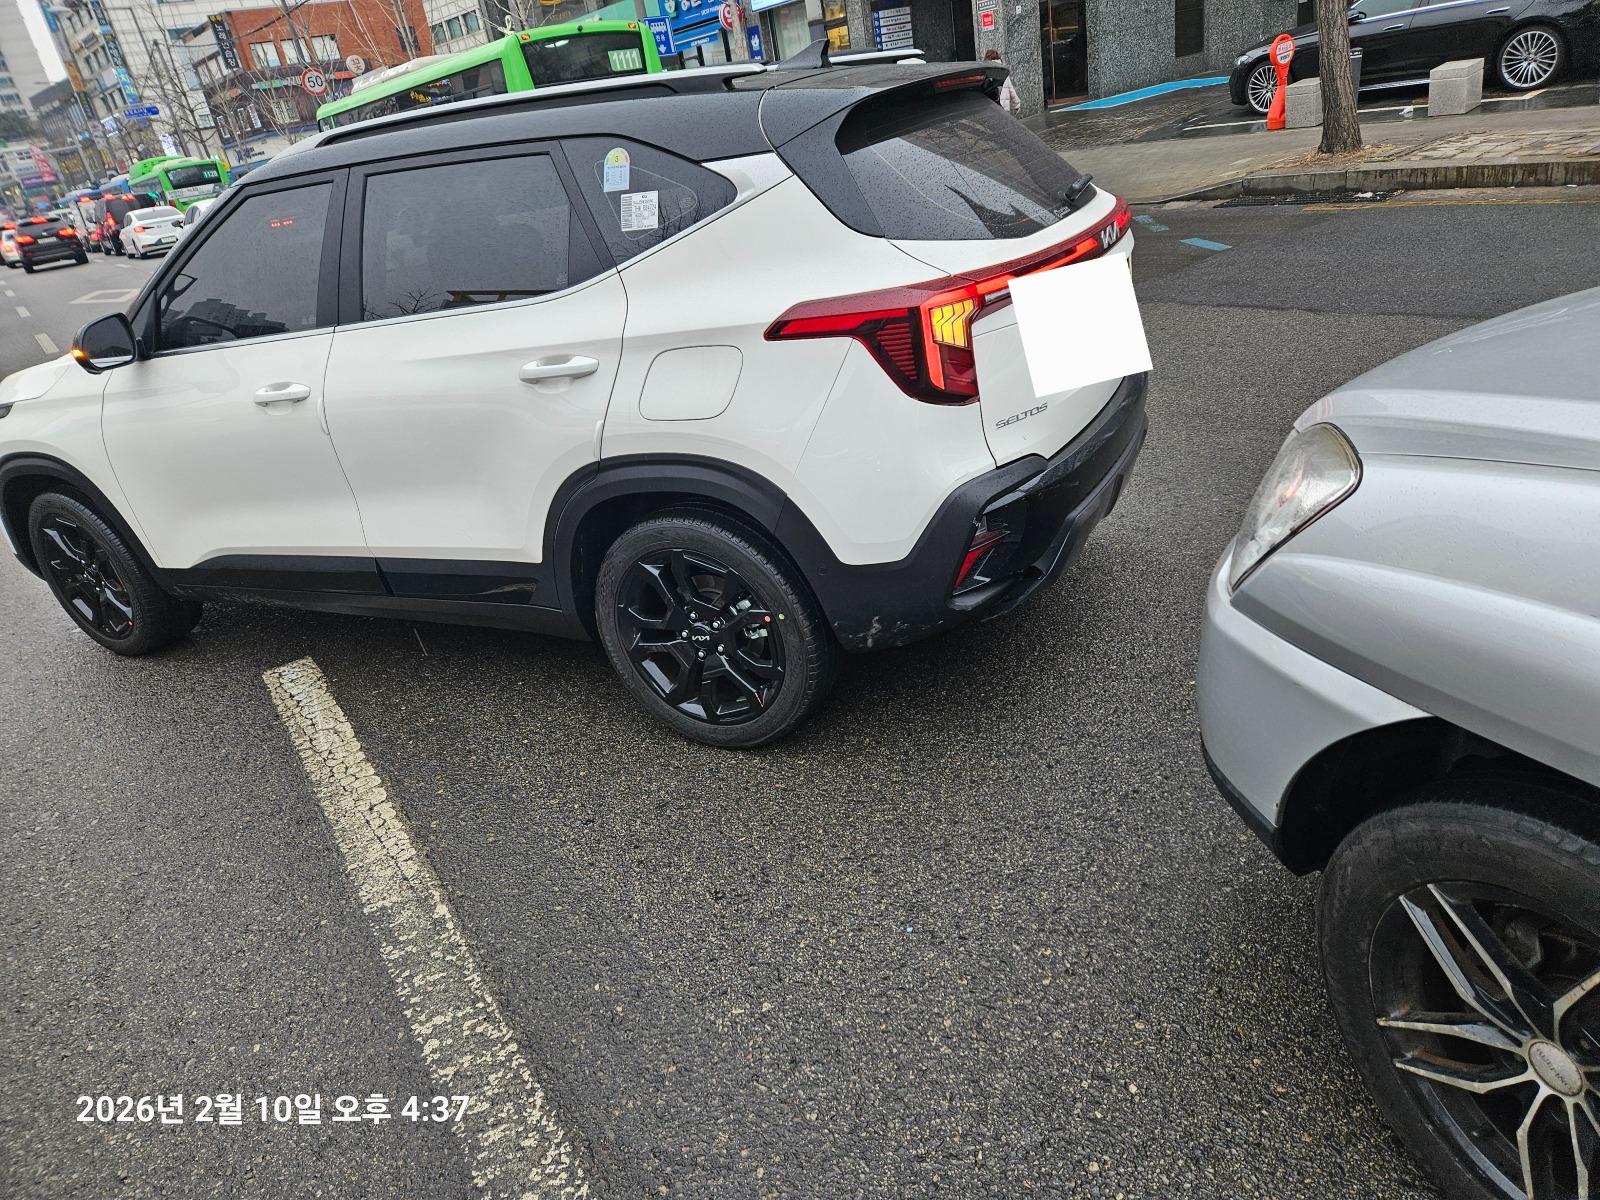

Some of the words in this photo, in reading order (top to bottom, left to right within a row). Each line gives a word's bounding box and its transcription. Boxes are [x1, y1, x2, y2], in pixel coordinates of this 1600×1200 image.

[612, 49, 640, 71] 1111
[307, 75, 324, 88] 50
[1101, 220, 1120, 249] KIA
[995, 401, 1048, 430] SELTOS
